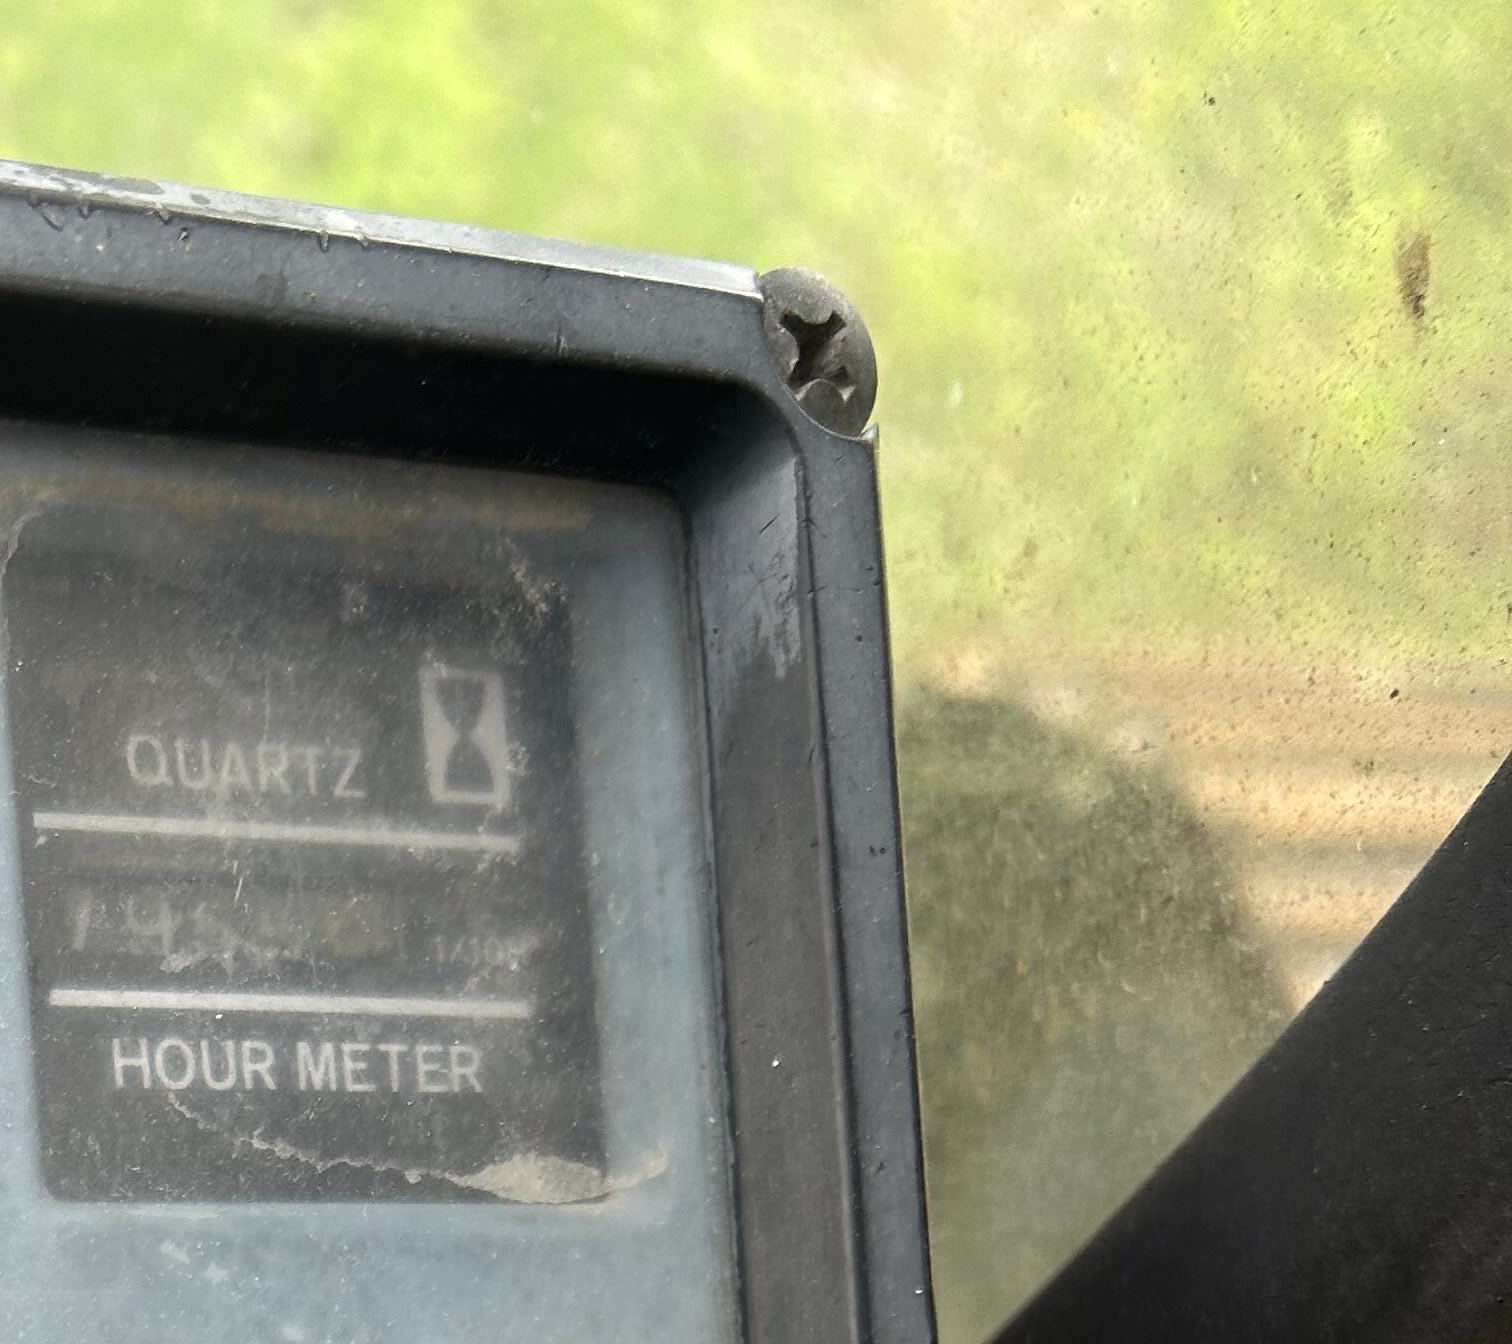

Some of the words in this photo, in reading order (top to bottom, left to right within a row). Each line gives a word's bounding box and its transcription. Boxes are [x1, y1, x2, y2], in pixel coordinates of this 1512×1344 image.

[126, 733, 367, 799] QUARTZ
[111, 1037, 277, 1092] HOUR
[296, 1040, 484, 1094] METER
